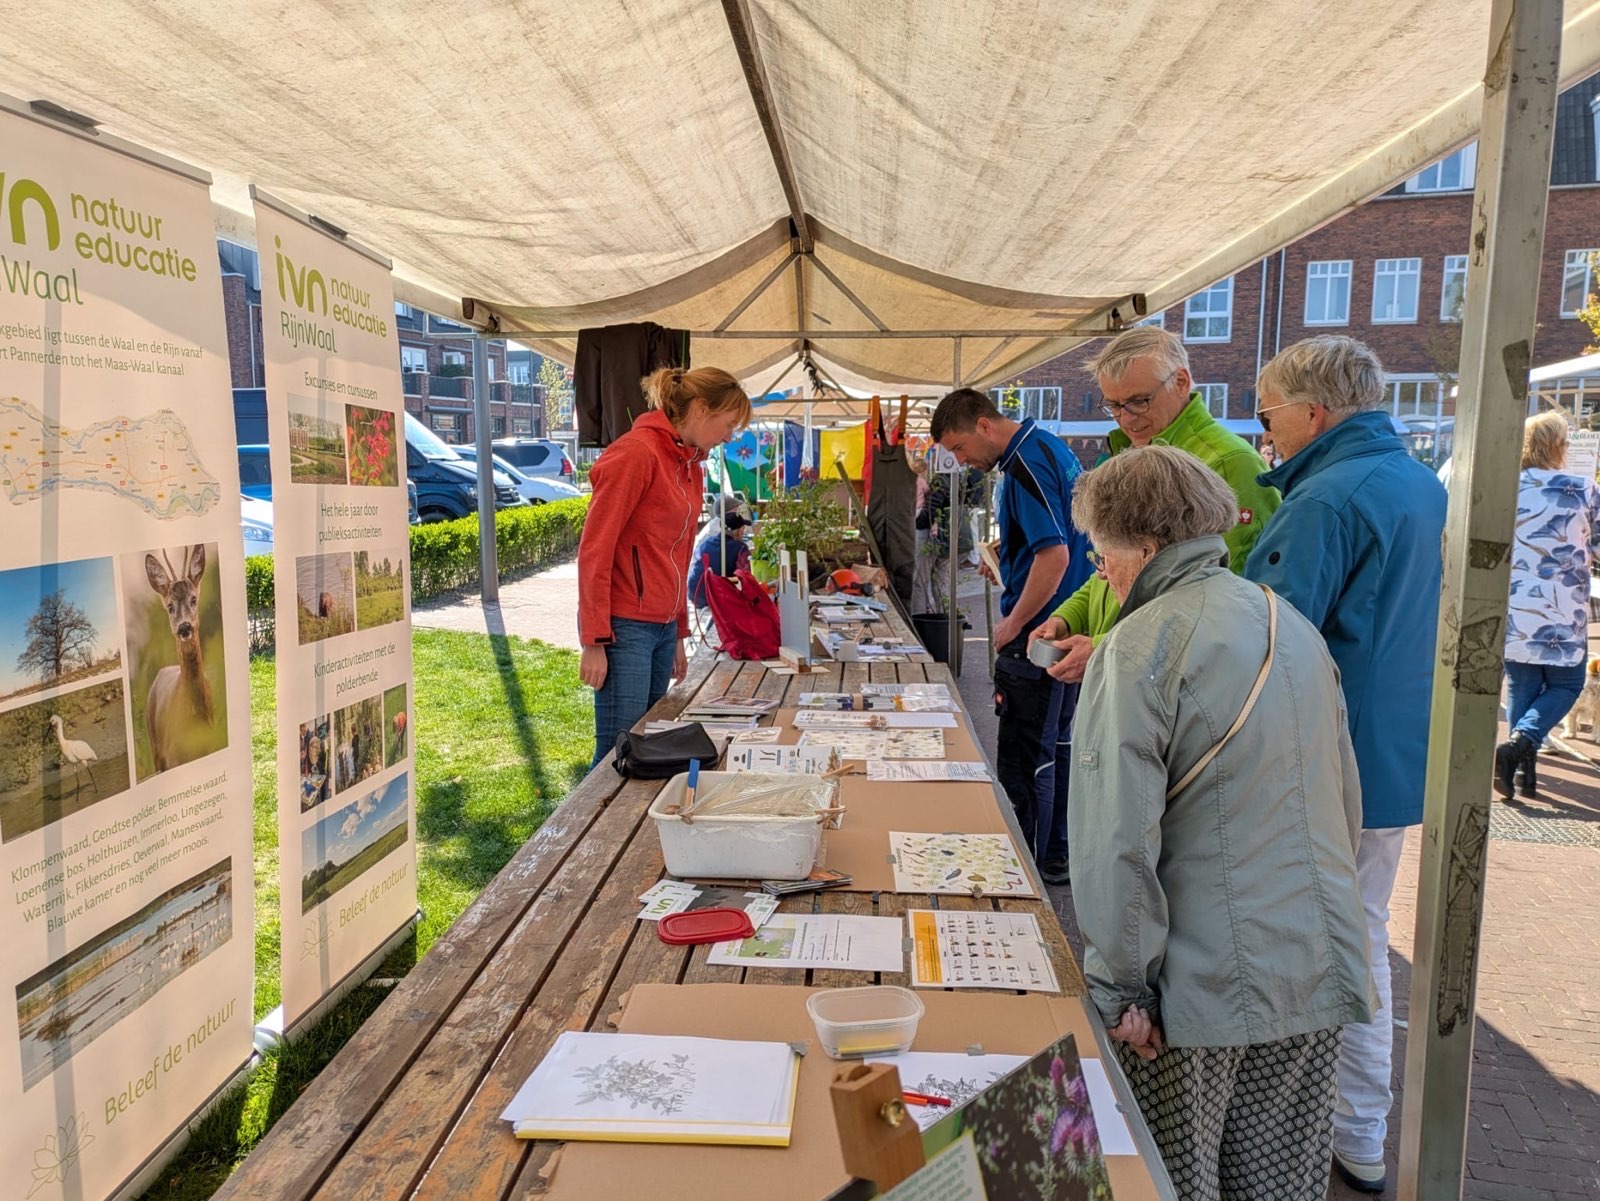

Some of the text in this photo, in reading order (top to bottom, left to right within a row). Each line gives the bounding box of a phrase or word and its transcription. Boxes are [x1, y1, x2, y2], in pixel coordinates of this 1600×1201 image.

[70, 193, 162, 241] natuur
[75, 232, 196, 282] educatie
[275, 234, 328, 317] ivn
[0, 254, 84, 305] Waal
[331, 277, 371, 309] natuur
[280, 310, 338, 353] RijnWaal
[333, 302, 387, 338] educatie
[10, 346, 69, 367] Pannerden
[70, 354, 86, 368] tot
[87, 353, 103, 369] het
[104, 355, 154, 374] Maas-Waal
[156, 359, 185, 376] kanaal
[44, 325, 62, 345] ligt
[64, 331, 97, 347] tussen
[98, 333, 110, 348] de
[111, 335, 135, 351] Waal
[137, 342, 149, 352] en
[150, 340, 161, 354] de
[163, 342, 180, 358] Rijn
[180, 346, 203, 359] vanaf
[304, 371, 378, 400] Excursies en cursussen
[320, 500, 379, 520] Het hele jaar door
[318, 524, 383, 545] publieksactiviteiten
[313, 641, 396, 678] Kinderactiviteiten met de
[336, 668, 379, 697] polderbende
[10, 834, 92, 885] Klompenwaard,
[92, 818, 131, 844] Gendtse
[158, 784, 203, 811] Bemmelse
[15, 871, 65, 905] Loenense
[66, 862, 87, 880] bos,
[87, 834, 140, 868] Holthuizen,
[23, 887, 75, 923] Waterrijk,
[47, 904, 85, 934] Blauwe
[84, 887, 115, 911] kamer
[115, 880, 127, 894] en
[128, 869, 145, 884] nog
[144, 859, 159, 875] veel
[160, 848, 181, 867] meer
[339, 862, 408, 928] Beleef de natuur
[104, 997, 237, 1125] Beleef de natuur
